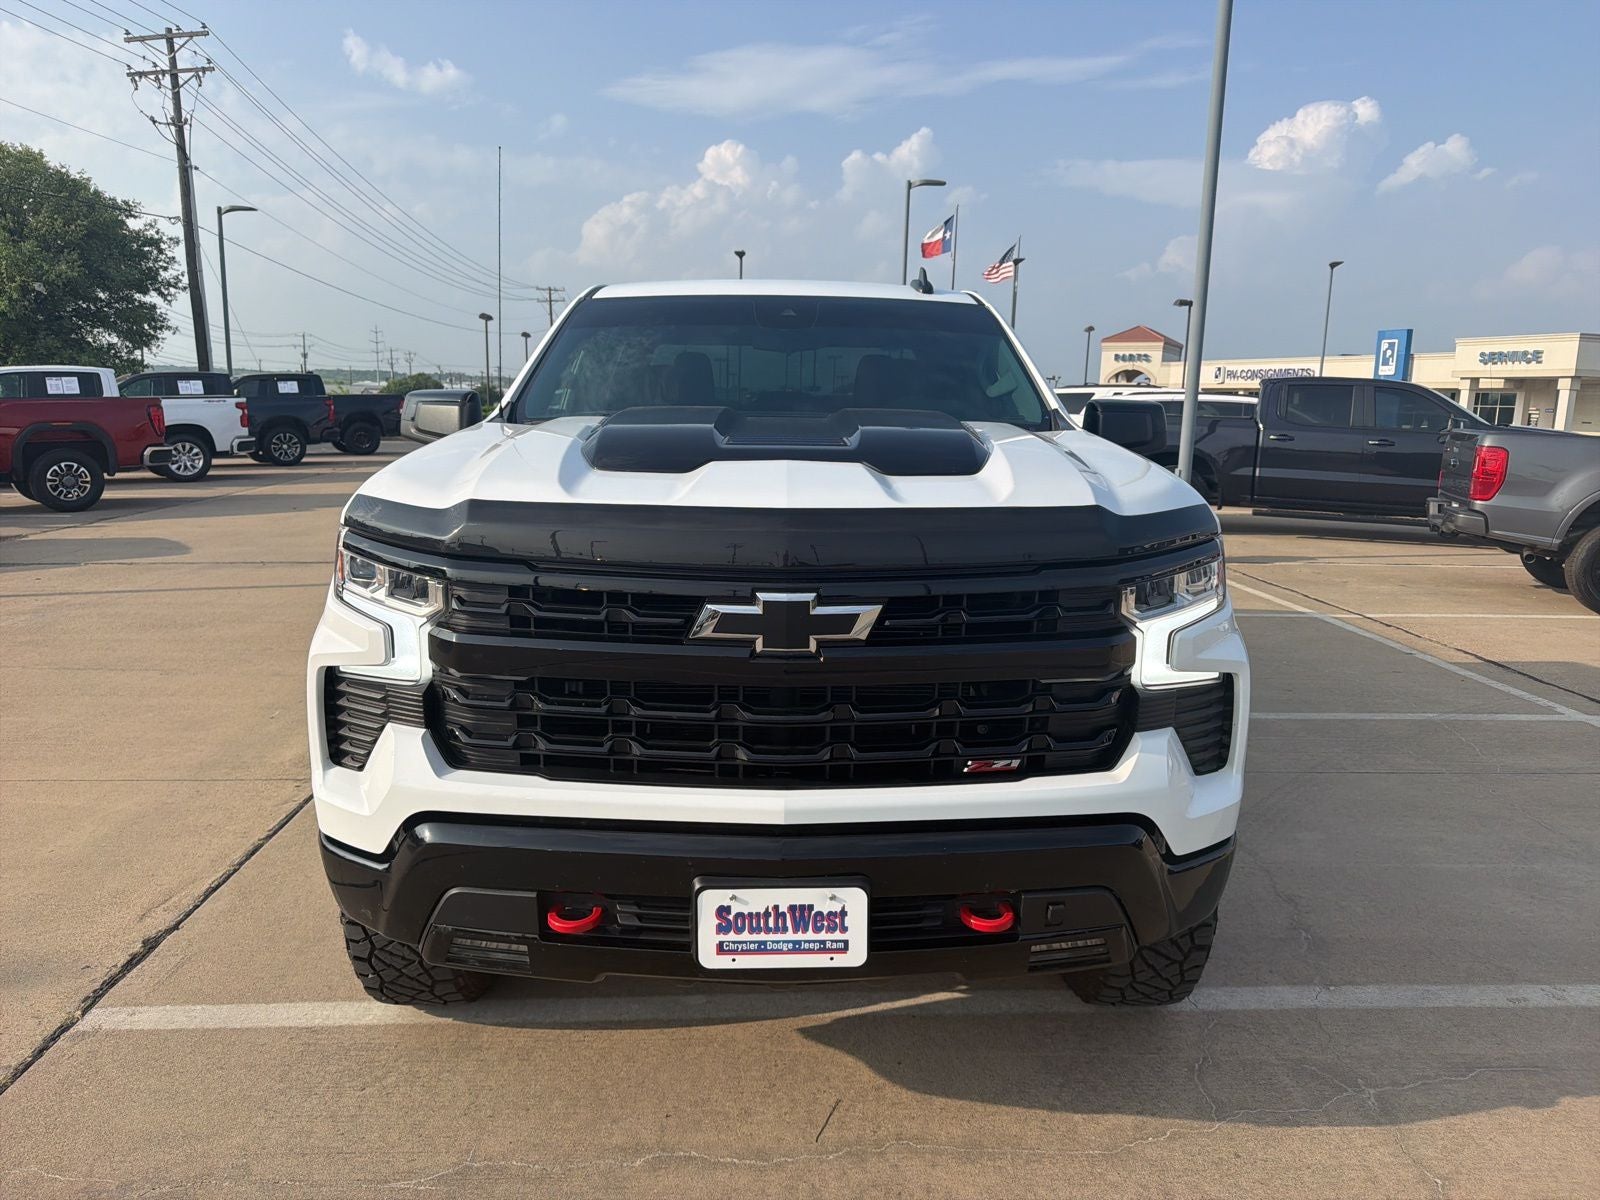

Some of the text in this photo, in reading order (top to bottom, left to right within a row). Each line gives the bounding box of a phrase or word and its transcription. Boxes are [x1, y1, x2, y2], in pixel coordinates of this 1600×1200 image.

[1479, 349, 1544, 365] SERVICE
[715, 904, 848, 935] SouthWest
[723, 940, 845, 951] Chrysler Dodge Jeep Ram
